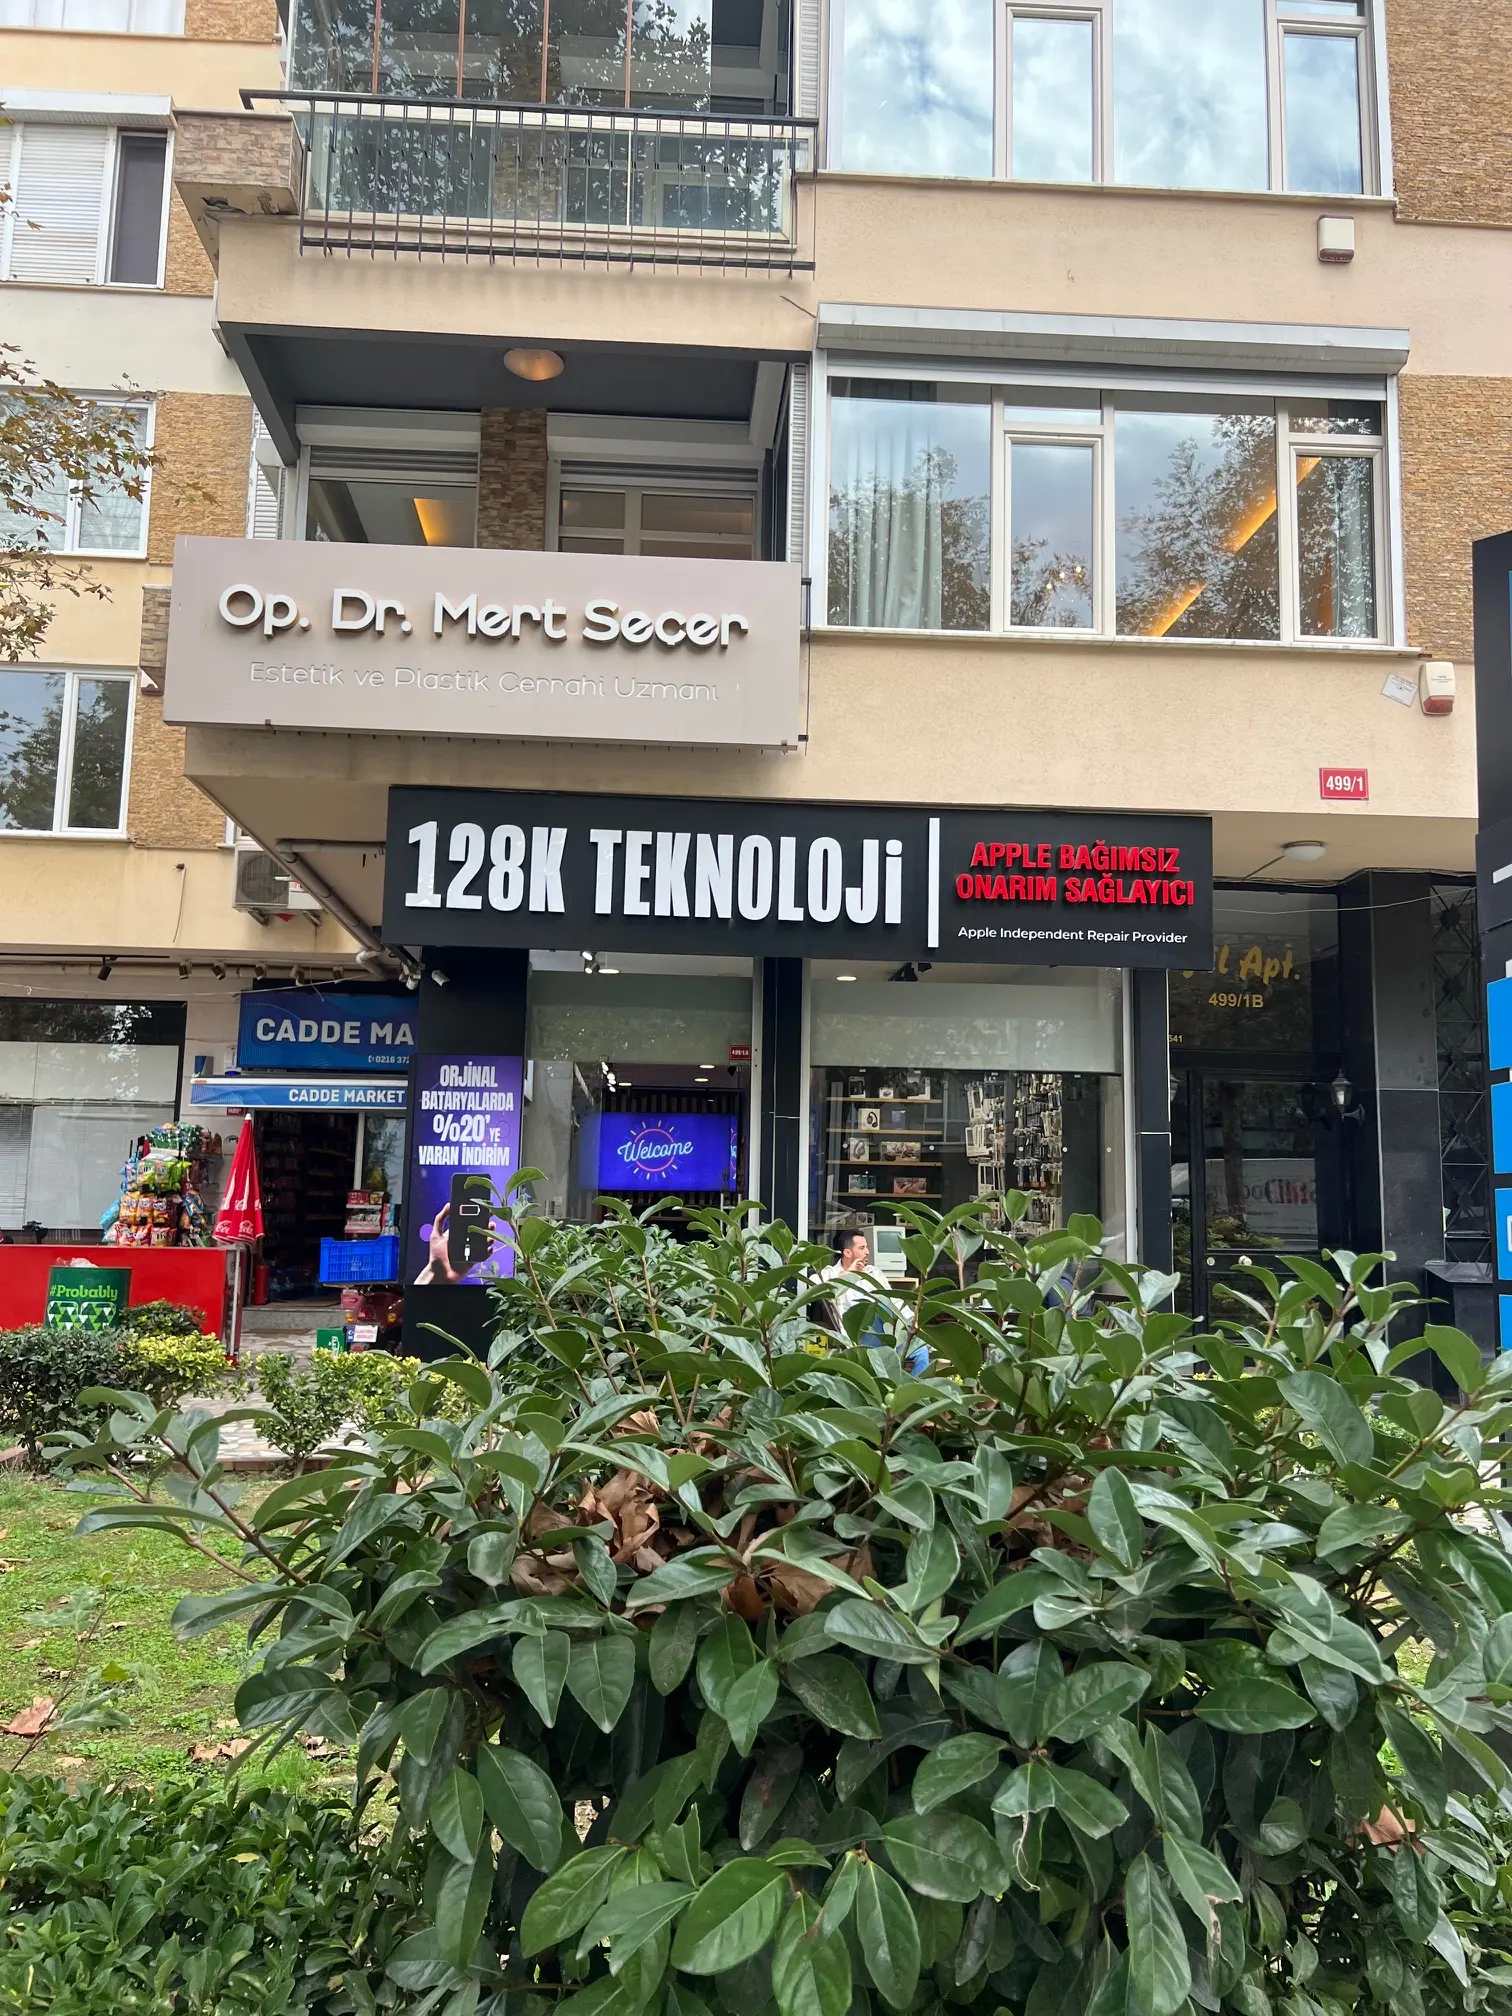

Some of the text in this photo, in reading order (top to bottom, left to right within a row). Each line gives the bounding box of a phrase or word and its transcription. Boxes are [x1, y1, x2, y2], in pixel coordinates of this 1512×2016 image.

[218, 583, 750, 650] Op. Dr. Mert Seçer
[249, 661, 719, 701] Estetik ve Plastik Cerrahi Uzmanı
[1326, 775, 1364, 792] 499/1
[404, 820, 568, 914] 128K
[970, 840, 1181, 874] APPLE BAĞIMSIZ
[955, 872, 1195, 906] ONARIM SAĞLAYICI
[957, 926, 1188, 945] Apple Independent Repair Provider
[1208, 993, 1264, 1008] 499/1B
[256, 1018, 361, 1044] CADDE
[375, 1055, 396, 1064] 0216
[439, 1061, 498, 1088] ORJİNAL
[288, 1088, 406, 1103] CADDE MARKET
[421, 1090, 514, 1112] BATARYALARDA
[418, 1142, 510, 1166] VARAN İNDİRİM
[617, 1139, 694, 1163] Welcome
[49, 1284, 118, 1302] #Probably
